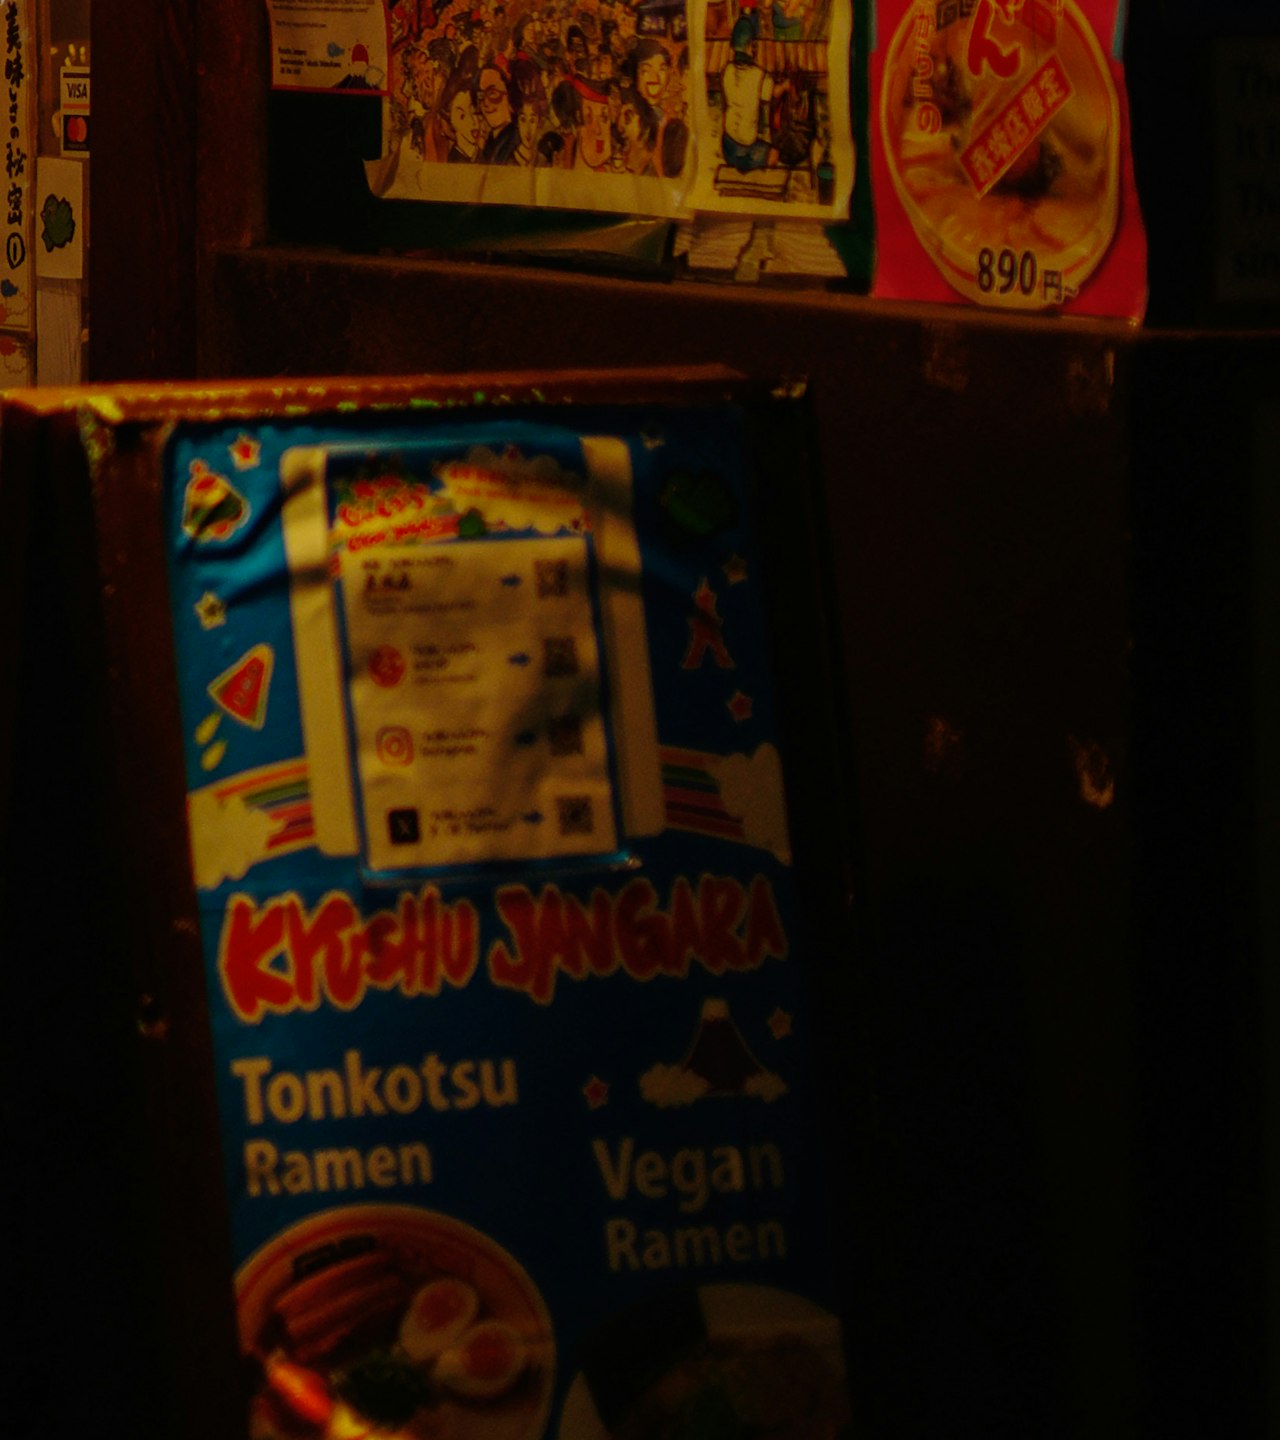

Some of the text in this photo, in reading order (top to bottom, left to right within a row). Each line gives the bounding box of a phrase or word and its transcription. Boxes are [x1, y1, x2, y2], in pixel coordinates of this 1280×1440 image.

[67, 82, 88, 99] VISA
[973, 62, 1070, 178] 赤坂店限定
[223, 874, 787, 1022] KYUSHU JANGARA
[231, 1048, 520, 1126] Tonkotsu
[244, 1140, 435, 1197] Ramen
[593, 1137, 785, 1214] Vegan
[604, 1217, 788, 1274] Ramen
